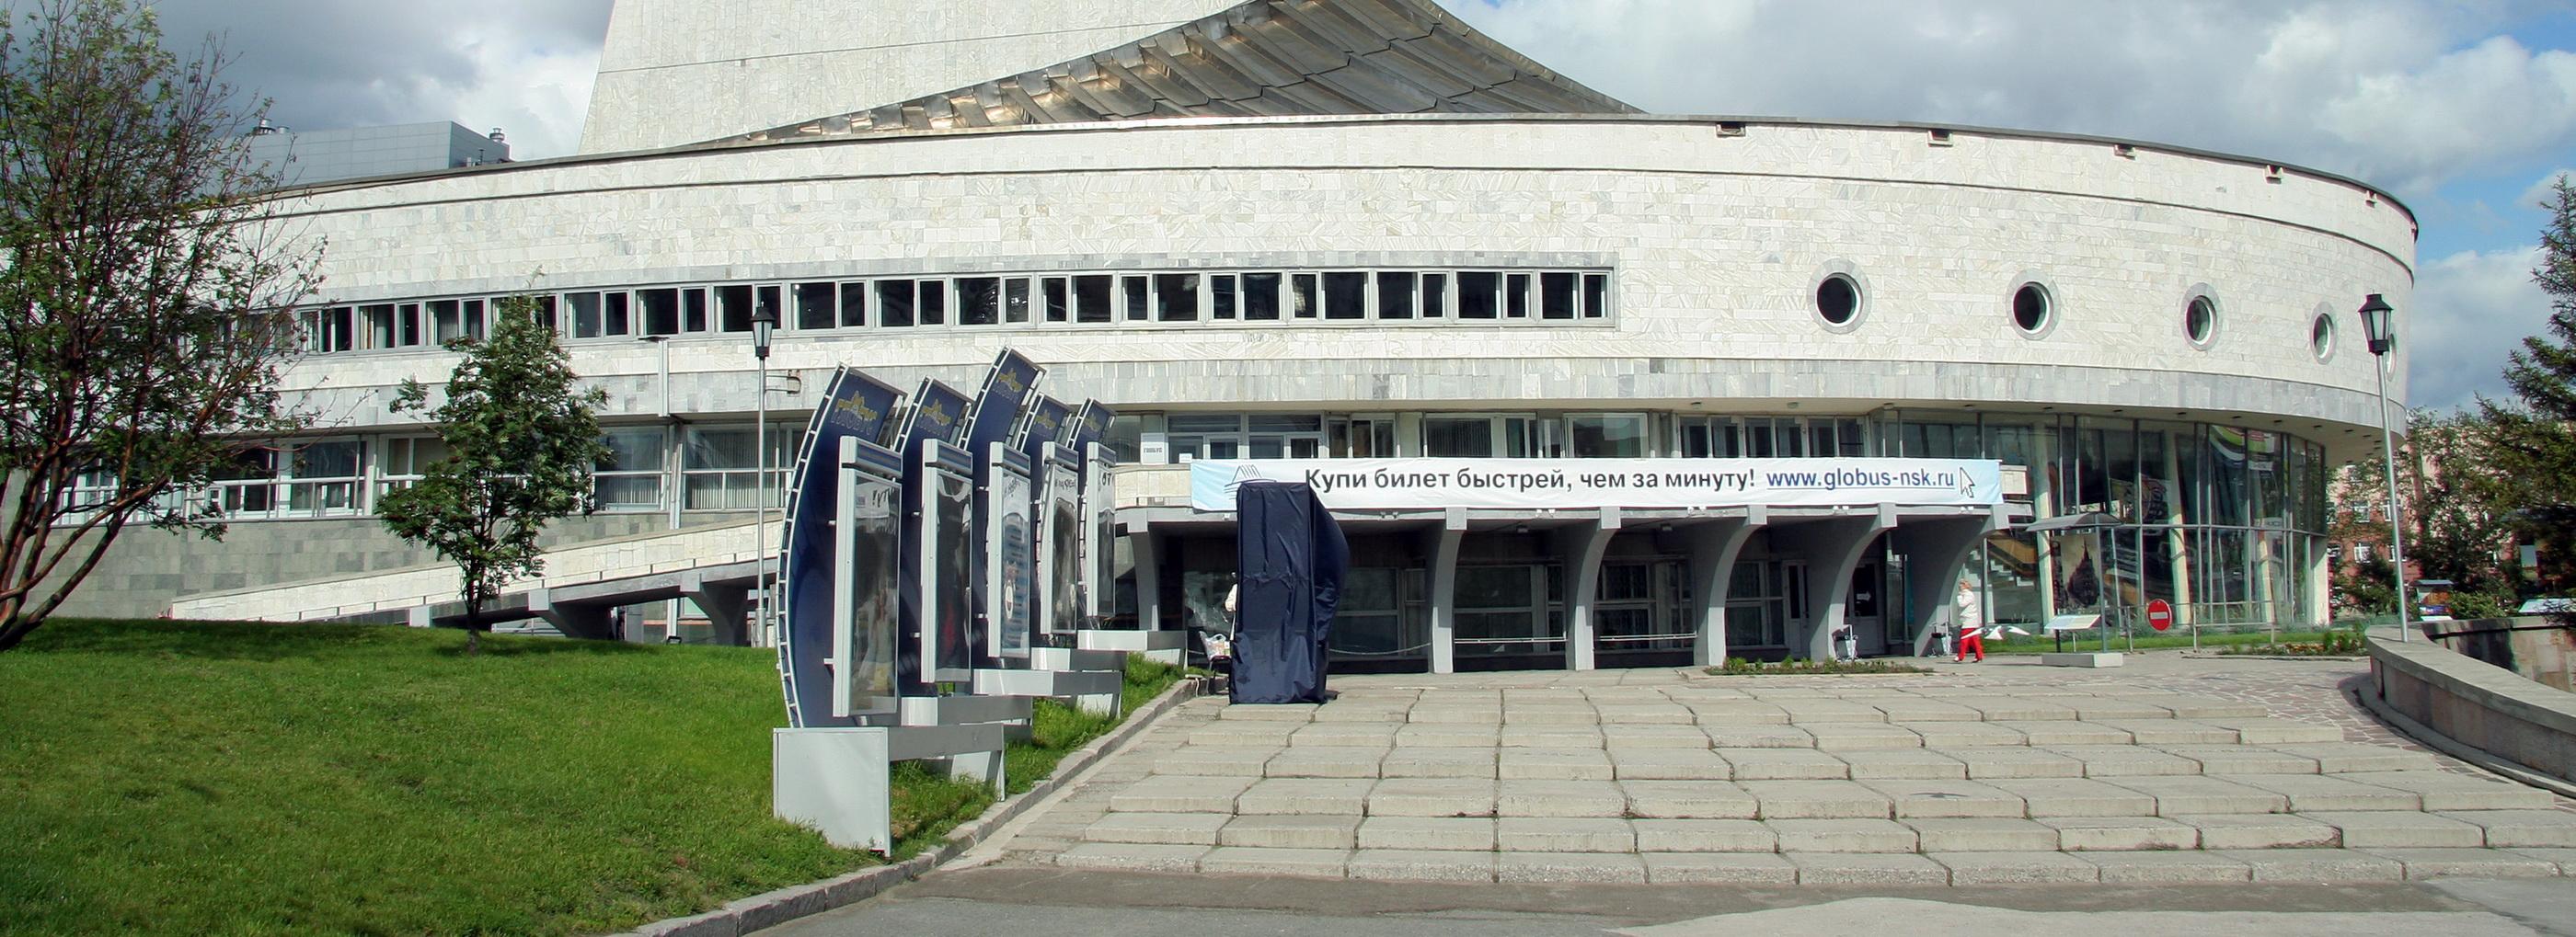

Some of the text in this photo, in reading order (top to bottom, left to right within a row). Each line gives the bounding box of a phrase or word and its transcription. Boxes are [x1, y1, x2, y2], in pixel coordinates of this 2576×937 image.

[1305, 467, 1756, 493] Купи билет быстрей, чем за минуту!
[1766, 467, 1955, 491] www.globus-nsk.ru
